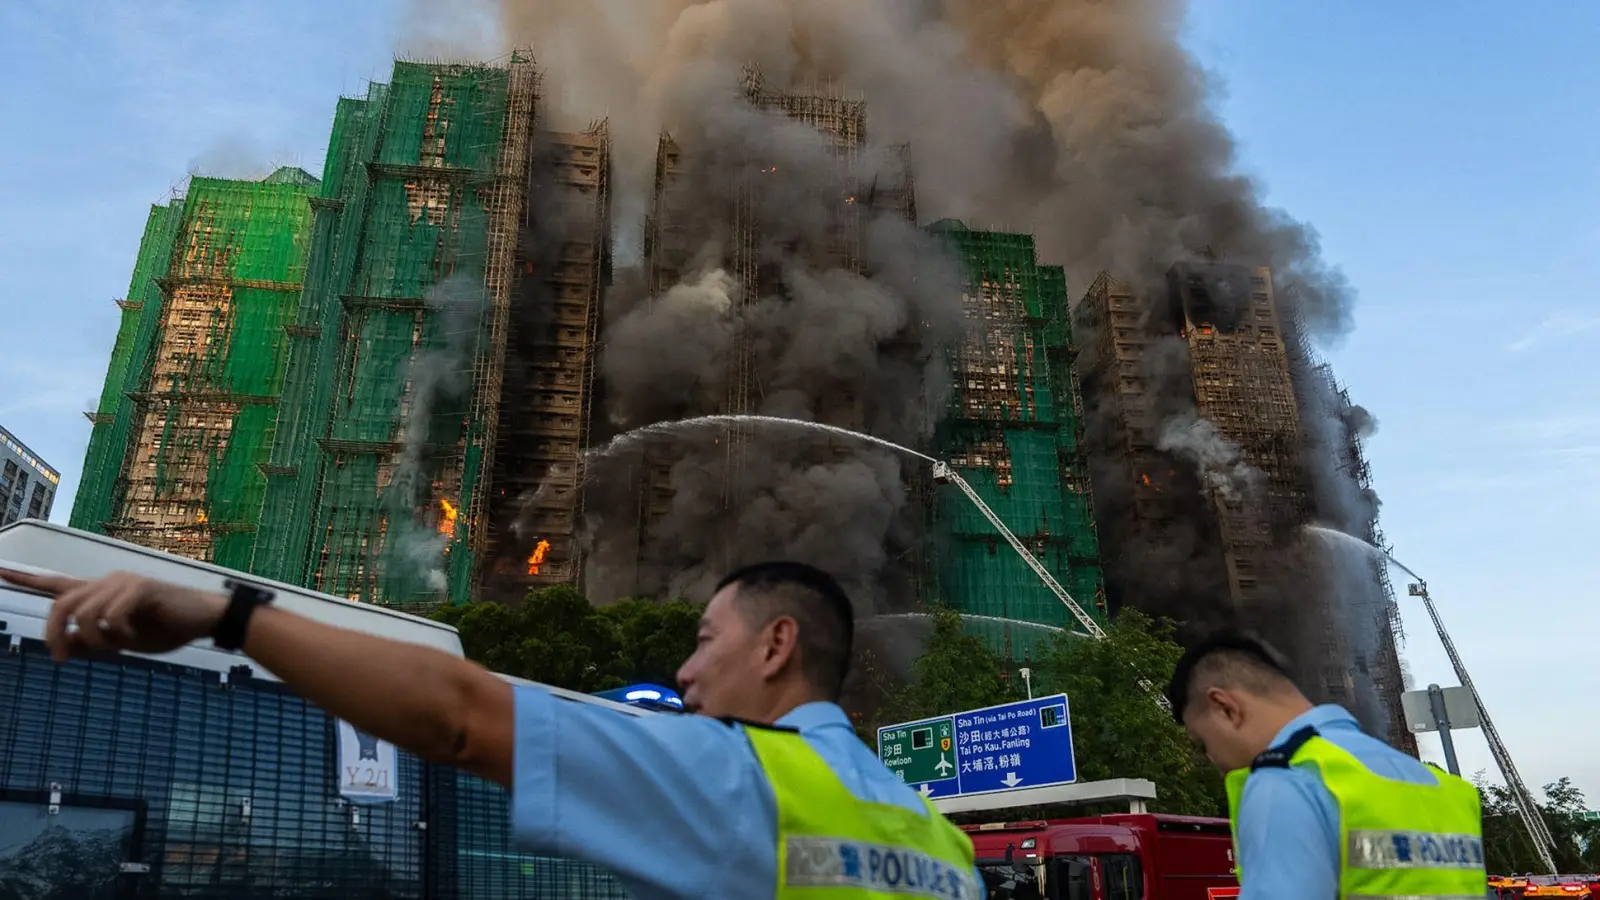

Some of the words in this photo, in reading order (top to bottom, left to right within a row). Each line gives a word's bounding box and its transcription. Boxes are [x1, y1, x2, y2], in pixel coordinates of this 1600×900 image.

[958, 718, 972, 728] Sha
[973, 716, 985, 725] Tin
[985, 716, 997, 724] (via
[997, 713, 1007, 721] Tai
[1017, 708, 1037, 717] Road)
[882, 732, 896, 742] Sha
[896, 730, 907, 739] Tin
[883, 743, 902, 758] 沙田
[960, 746, 971, 755] Tai
[972, 744, 983, 754] Po
[1002, 738, 1031, 749] Fanling
[884, 756, 912, 768] Kowloon
[346, 766, 360, 786] Y
[364, 767, 389, 788] 2/1
